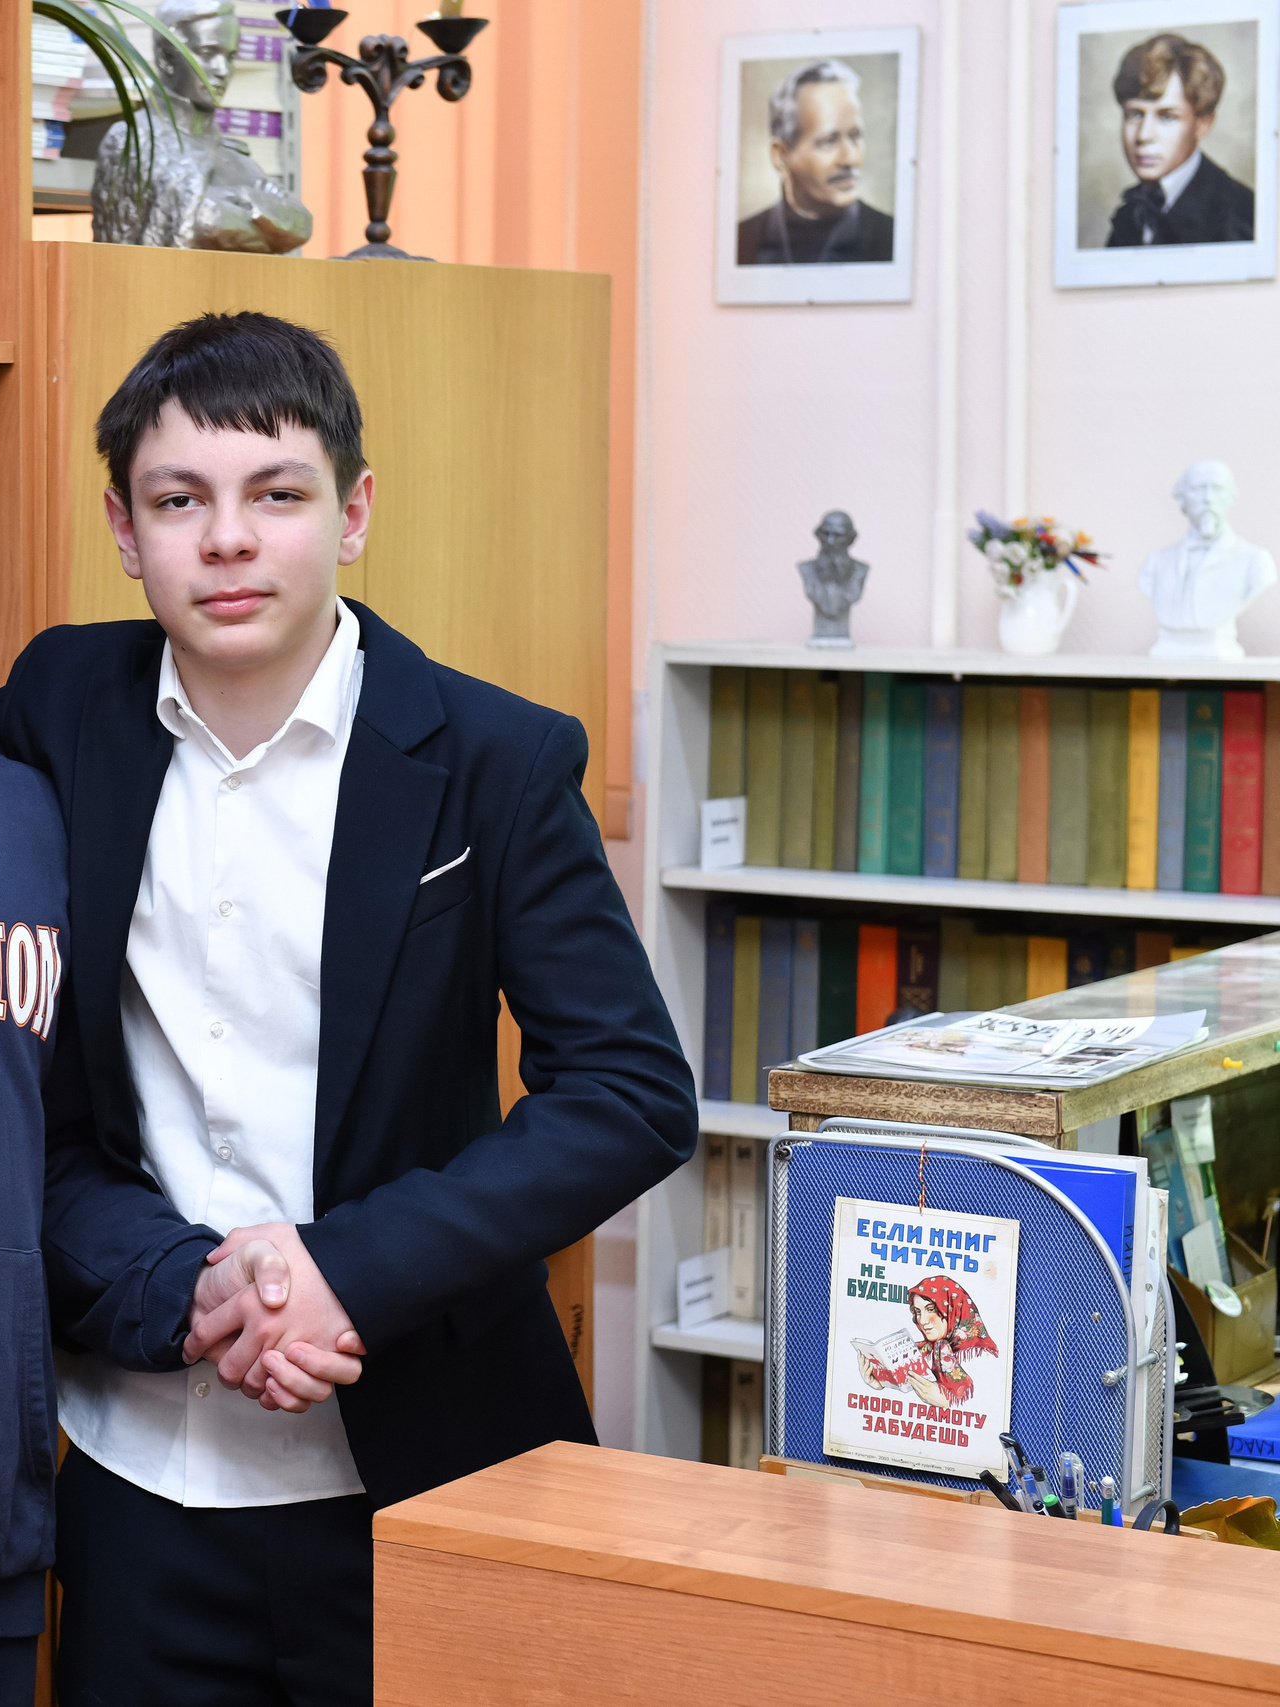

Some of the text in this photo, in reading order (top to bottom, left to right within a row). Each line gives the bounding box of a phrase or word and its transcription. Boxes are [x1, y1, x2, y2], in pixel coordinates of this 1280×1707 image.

[857, 1218, 997, 1253] ЕСЛИ КНИГ
[860, 1263, 886, 1279] НЕ
[870, 1242, 979, 1273] ЧИТАТЬ
[847, 1393, 987, 1429] СКОРО ГРАМОТУ
[862, 1414, 969, 1448] ЗАБУДЕШЬ
